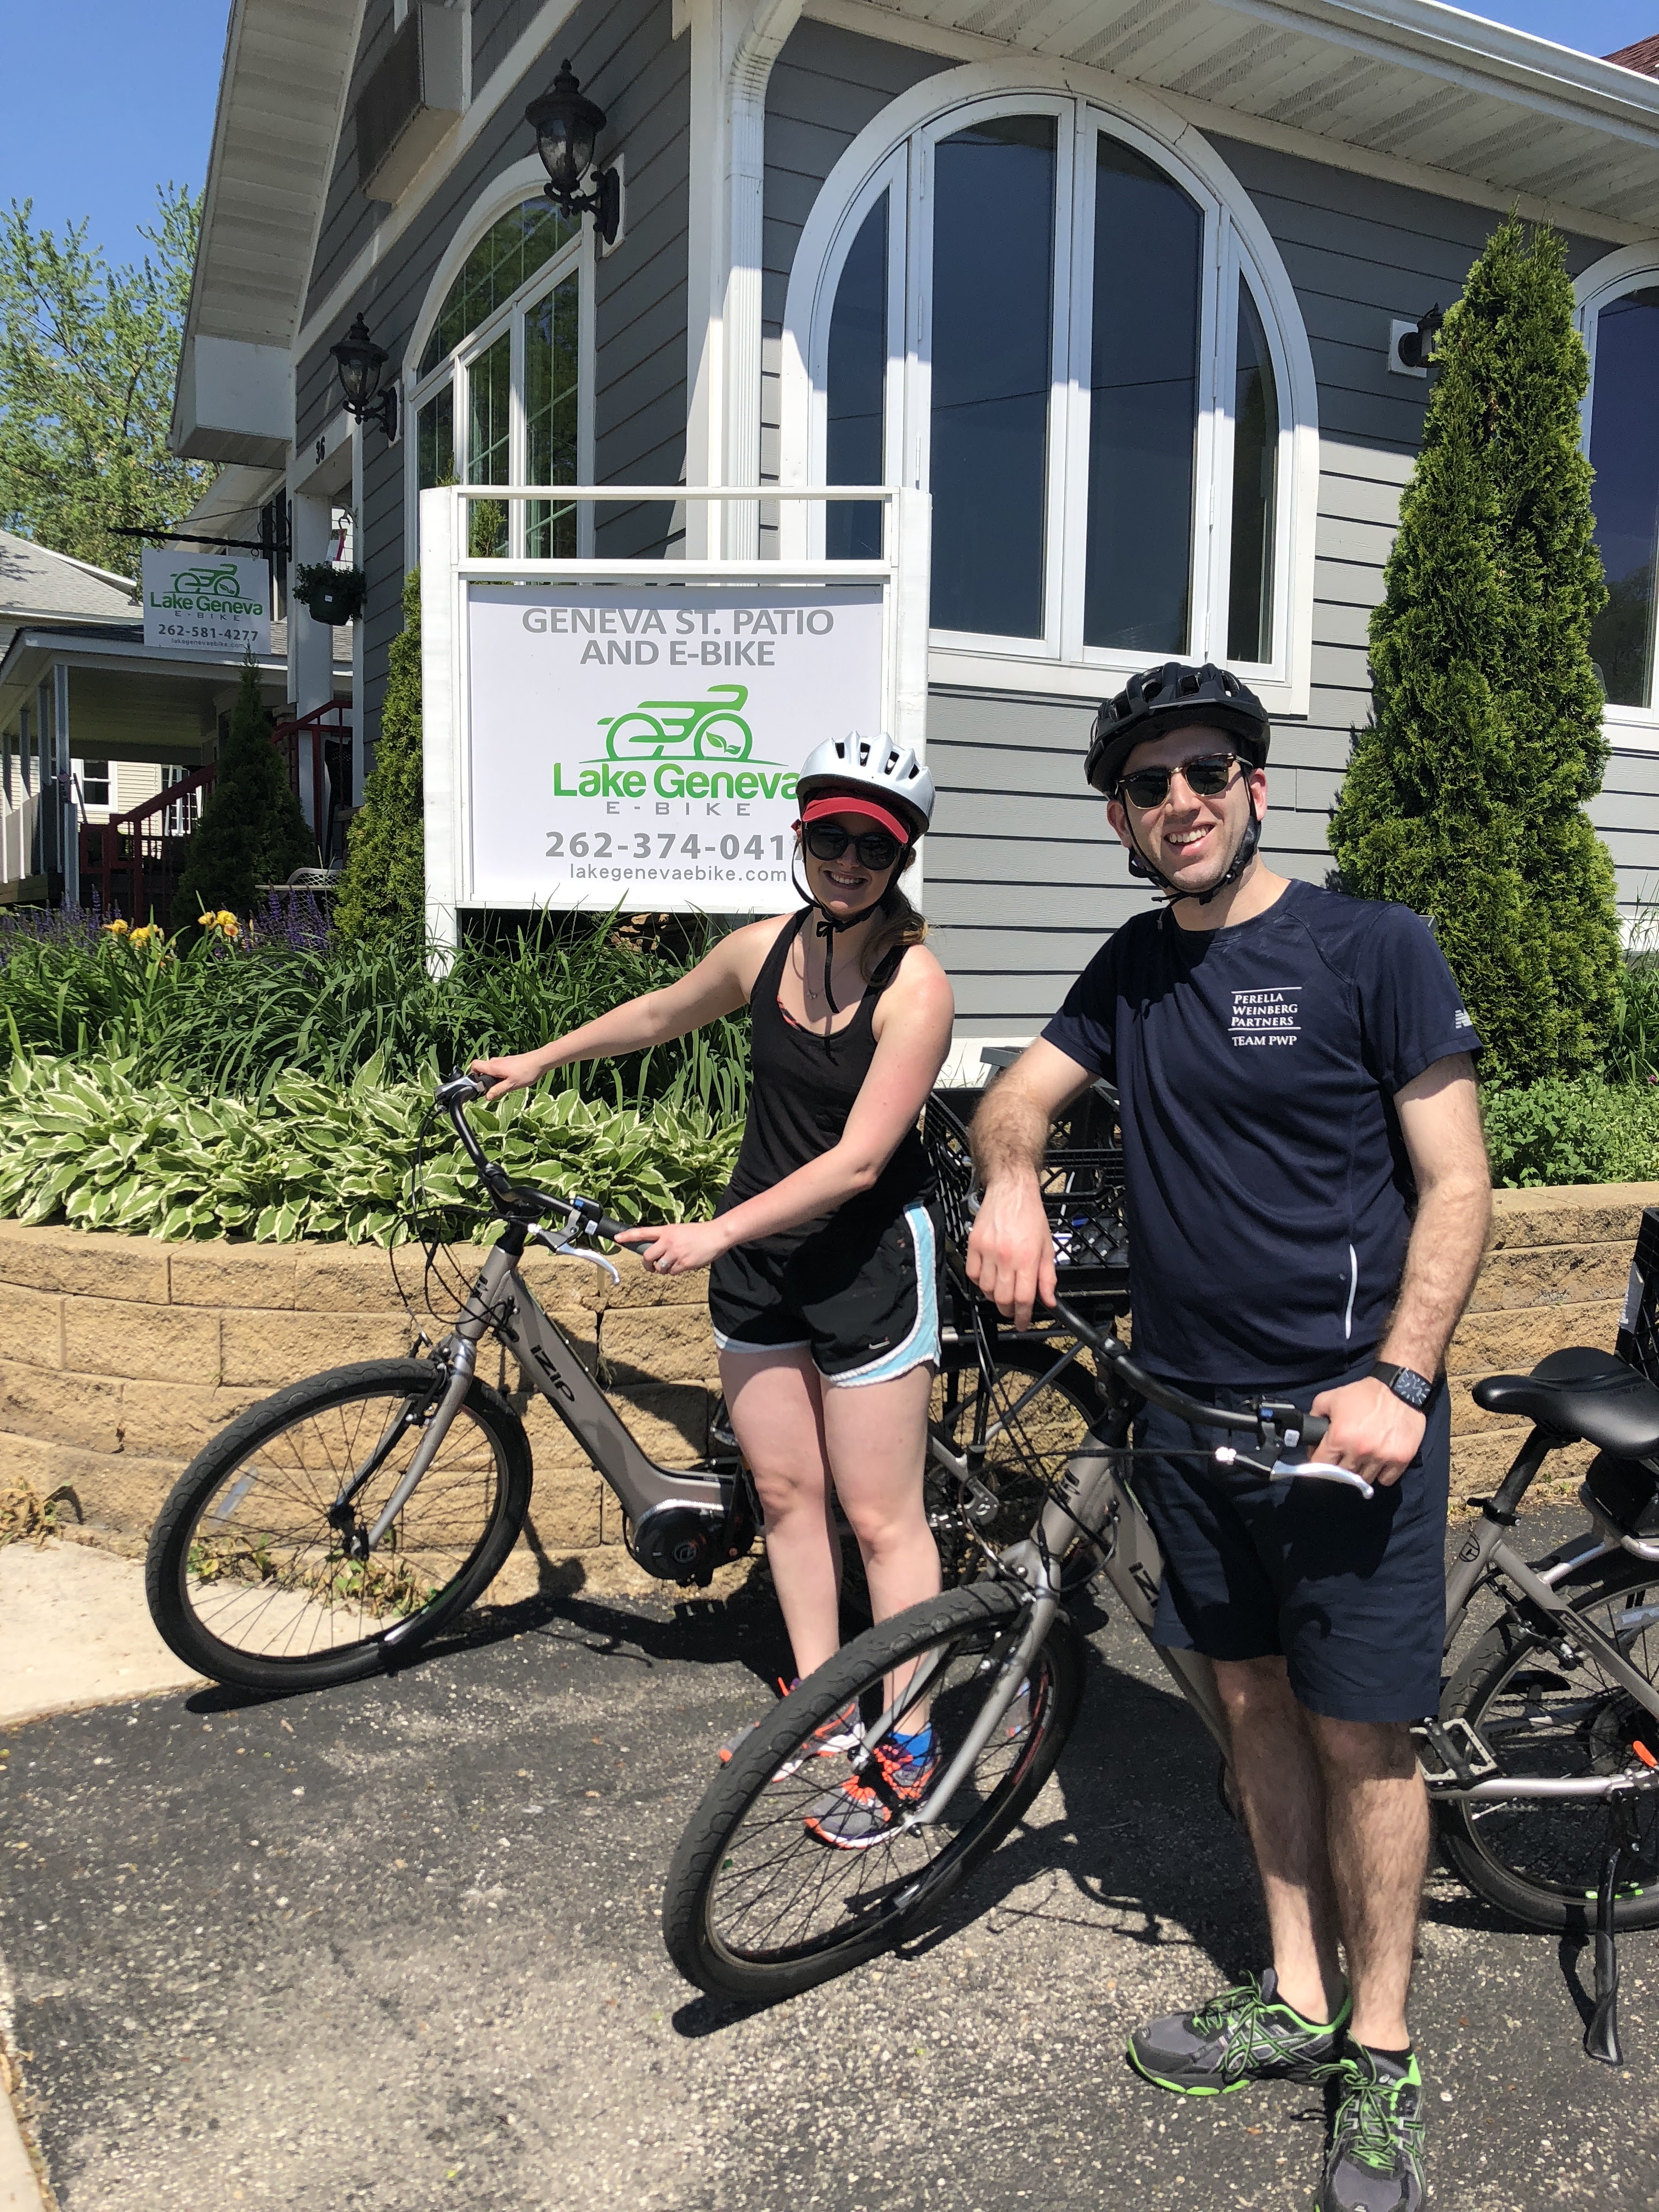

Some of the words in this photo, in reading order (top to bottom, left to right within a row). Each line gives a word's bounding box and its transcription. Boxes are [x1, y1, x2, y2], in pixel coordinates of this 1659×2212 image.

[150, 591, 194, 610] Lake
[196, 595, 263, 616] Geneva
[174, 610, 241, 622] E-BIKE
[522, 608, 667, 635] GENEVA
[675, 609, 721, 635] ST.
[733, 610, 834, 635] PATIO
[158, 623, 258, 641] 262-581-4277
[580, 640, 659, 665] AND
[670, 640, 775, 667] E-BIKE
[554, 763, 646, 798] Lake
[653, 763, 800, 800] Geneva
[606, 801, 751, 817] E-BIKE
[570, 863, 787, 882] lakegenevaebike.com
[1234, 992, 1284, 1005] PERELLA
[1232, 1003, 1299, 1015] WEINBERG
[1231, 1016, 1294, 1027] PARTNERS
[1231, 1036, 1266, 1047] TEAM
[1268, 1035, 1297, 1046] PWP
[530, 1344, 575, 1402] IZIP
